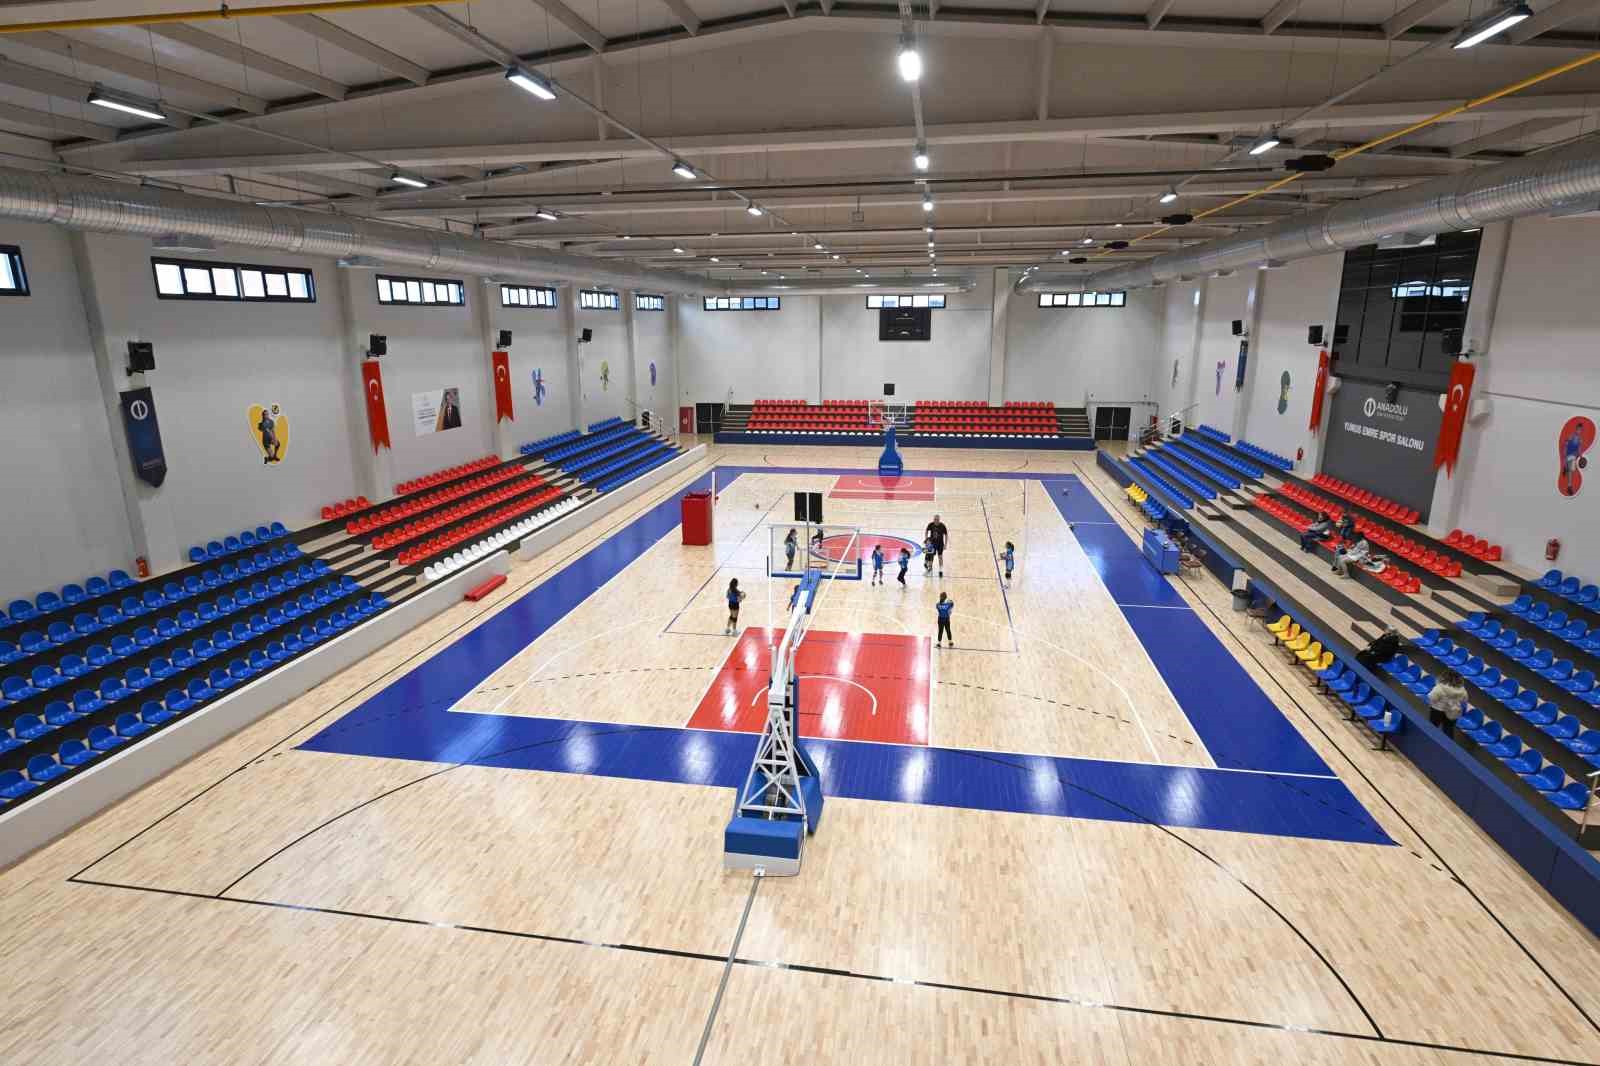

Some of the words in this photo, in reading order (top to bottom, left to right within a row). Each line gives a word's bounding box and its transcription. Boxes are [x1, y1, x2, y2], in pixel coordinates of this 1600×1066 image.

[1376, 402, 1408, 416] ANADOLU
[1344, 422, 1361, 434] YUNUS
[1362, 426, 1379, 439] EMRE
[1379, 430, 1397, 444] SPOR
[1397, 434, 1425, 451] SALONU
